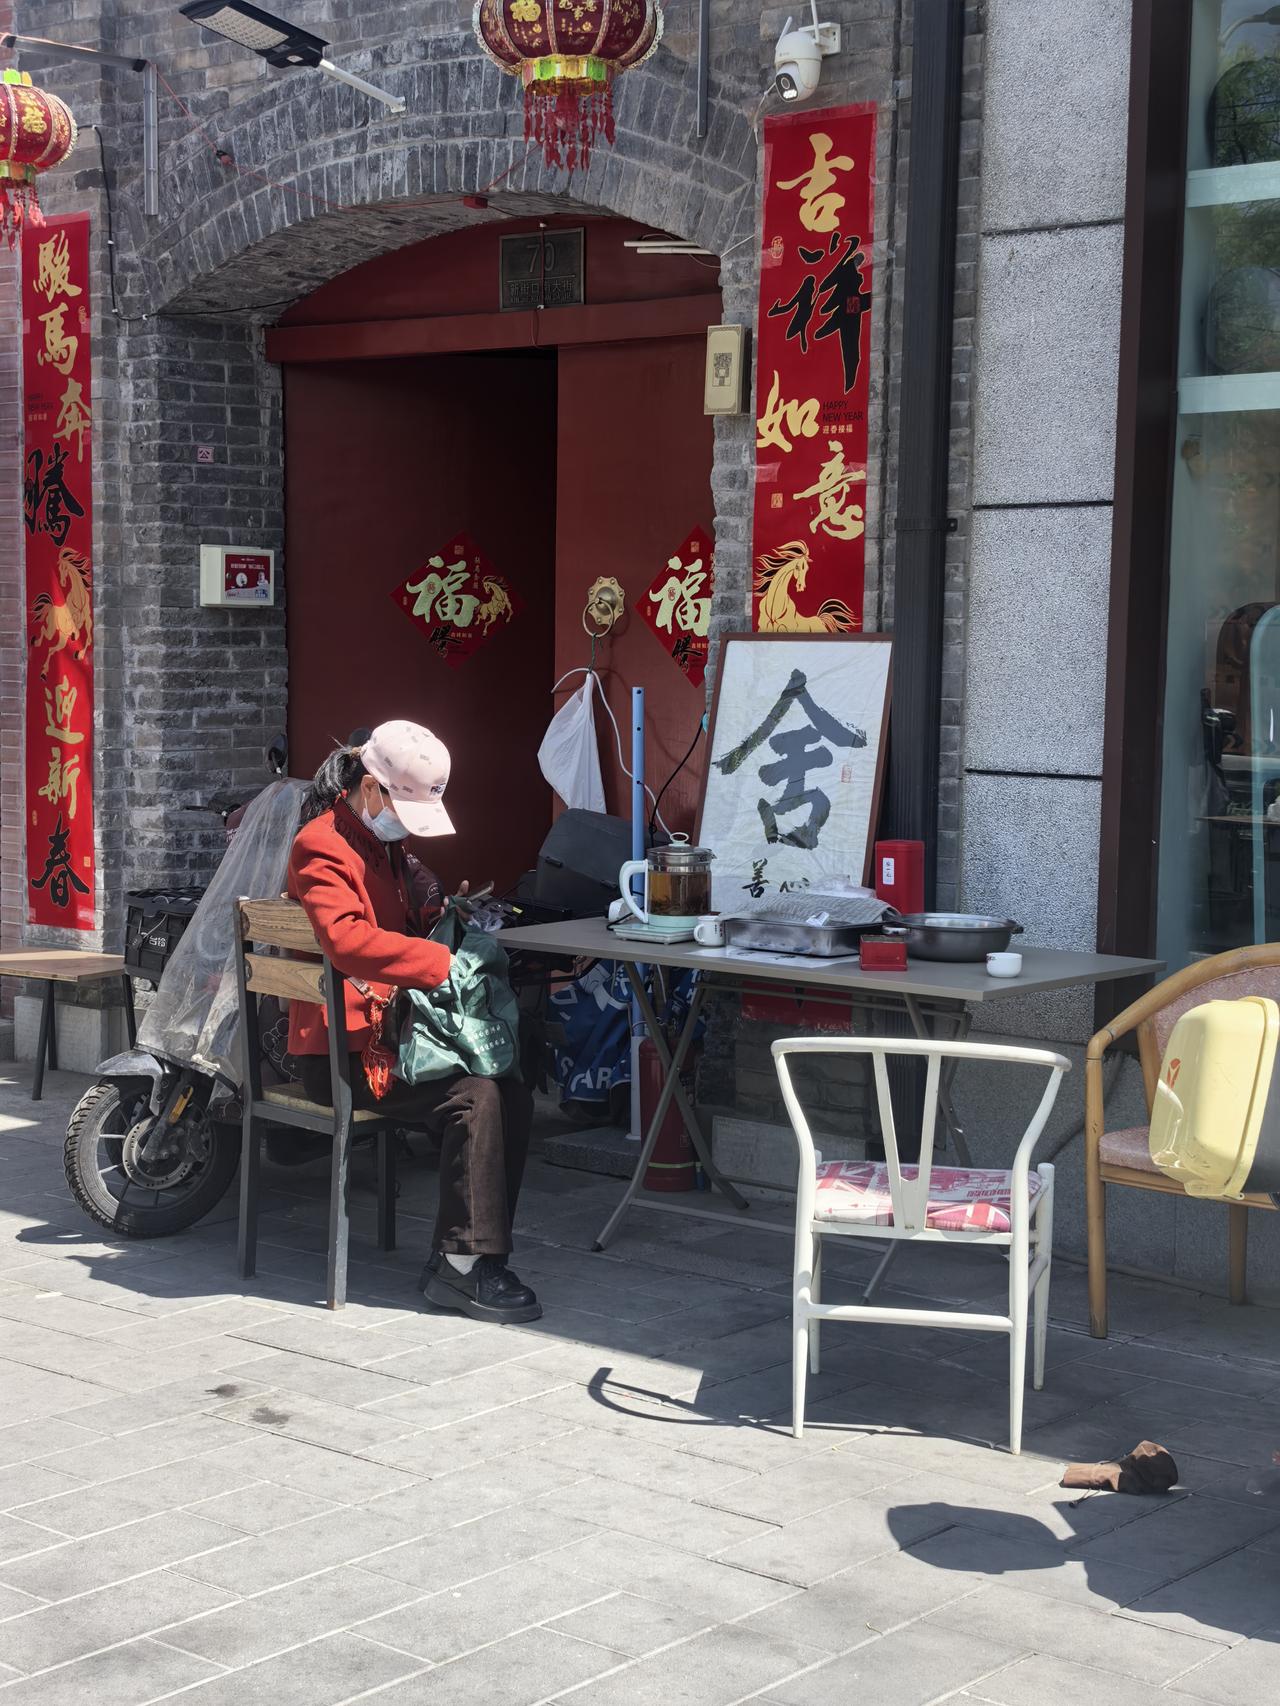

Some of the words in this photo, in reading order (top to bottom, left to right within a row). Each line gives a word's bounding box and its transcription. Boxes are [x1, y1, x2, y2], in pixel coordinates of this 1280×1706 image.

[526, 241, 555, 273] 70
[757, 132, 872, 541] 吉祥如意
[822, 401, 847, 410] HAPPY
[822, 412, 841, 422] NEW
[843, 411, 864, 421] YEAR
[406, 555, 481, 628] 福
[649, 556, 712, 637] 福
[711, 667, 868, 851] 舍
